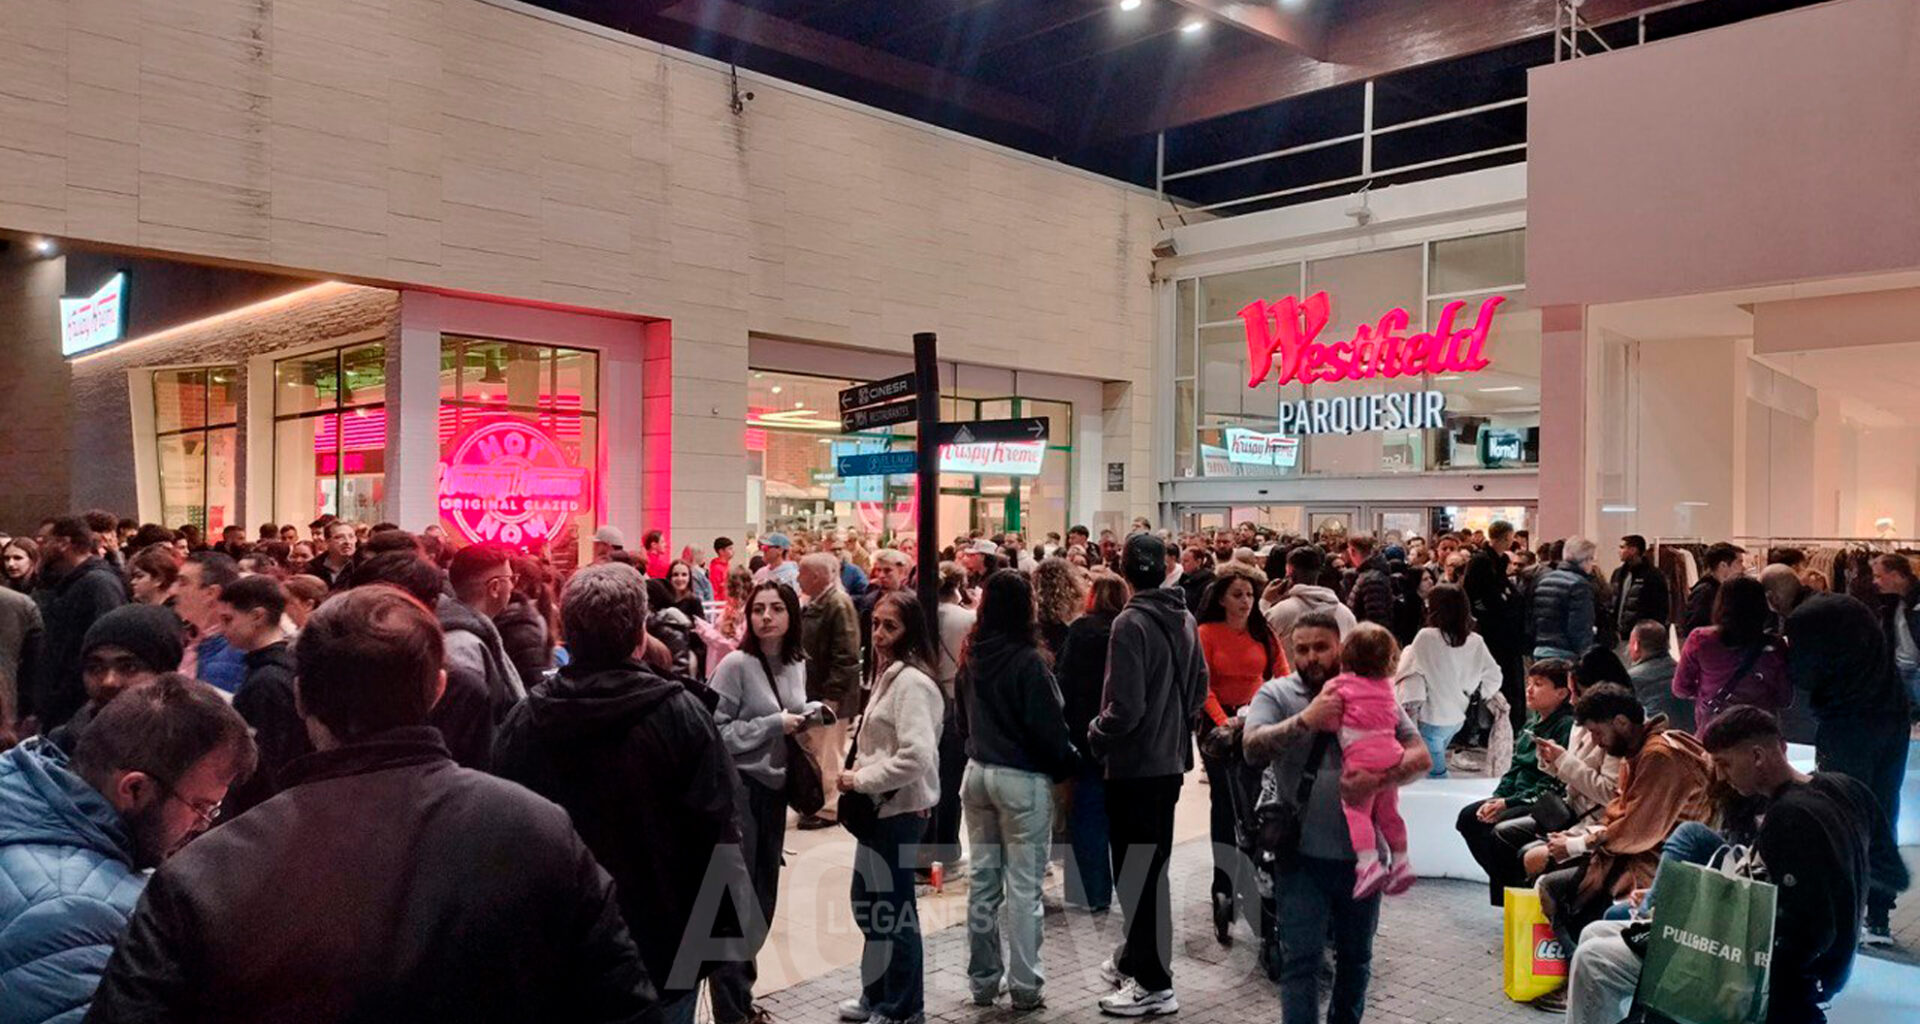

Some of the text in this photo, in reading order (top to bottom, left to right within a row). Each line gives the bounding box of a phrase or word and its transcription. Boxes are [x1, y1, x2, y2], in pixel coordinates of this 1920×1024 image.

[1237, 291, 1505, 388] Westfield
[1279, 390, 1445, 435] PARQUESUR
[478, 431, 547, 462] HOT
[1489, 436, 1519, 459] Normal
[440, 497, 580, 512] ORIGINAL GLAZED
[476, 513, 549, 545] NOW
[1662, 924, 1743, 964] PULL&BEAR
